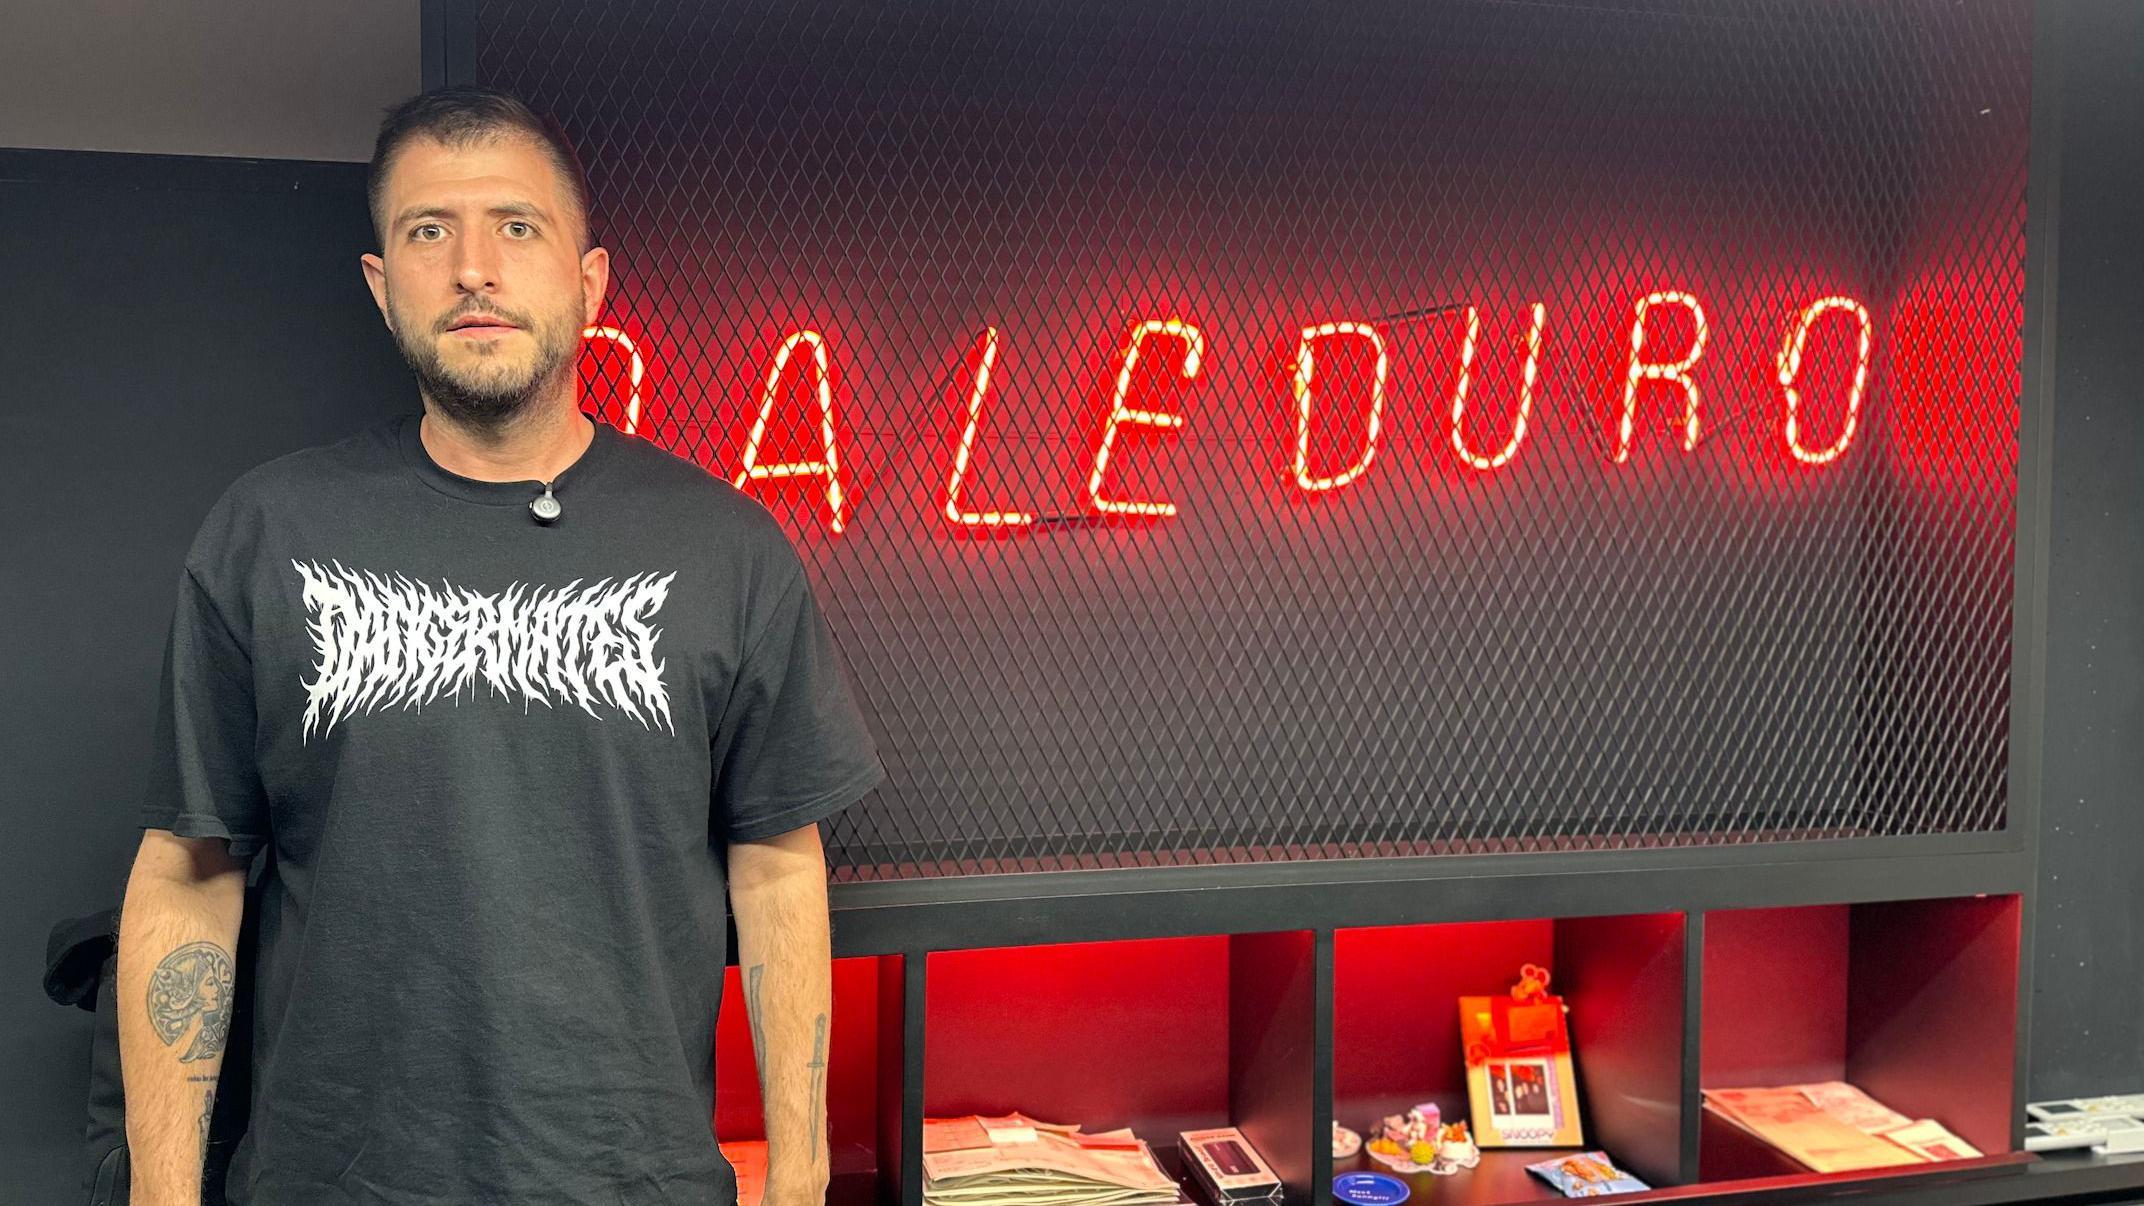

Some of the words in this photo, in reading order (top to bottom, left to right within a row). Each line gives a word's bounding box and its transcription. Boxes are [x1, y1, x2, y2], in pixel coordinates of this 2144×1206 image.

[1292, 290, 1872, 493] DURO
[291, 557, 678, 748] DANGERMATES
[1502, 1128, 1555, 1141] SNOOPY
